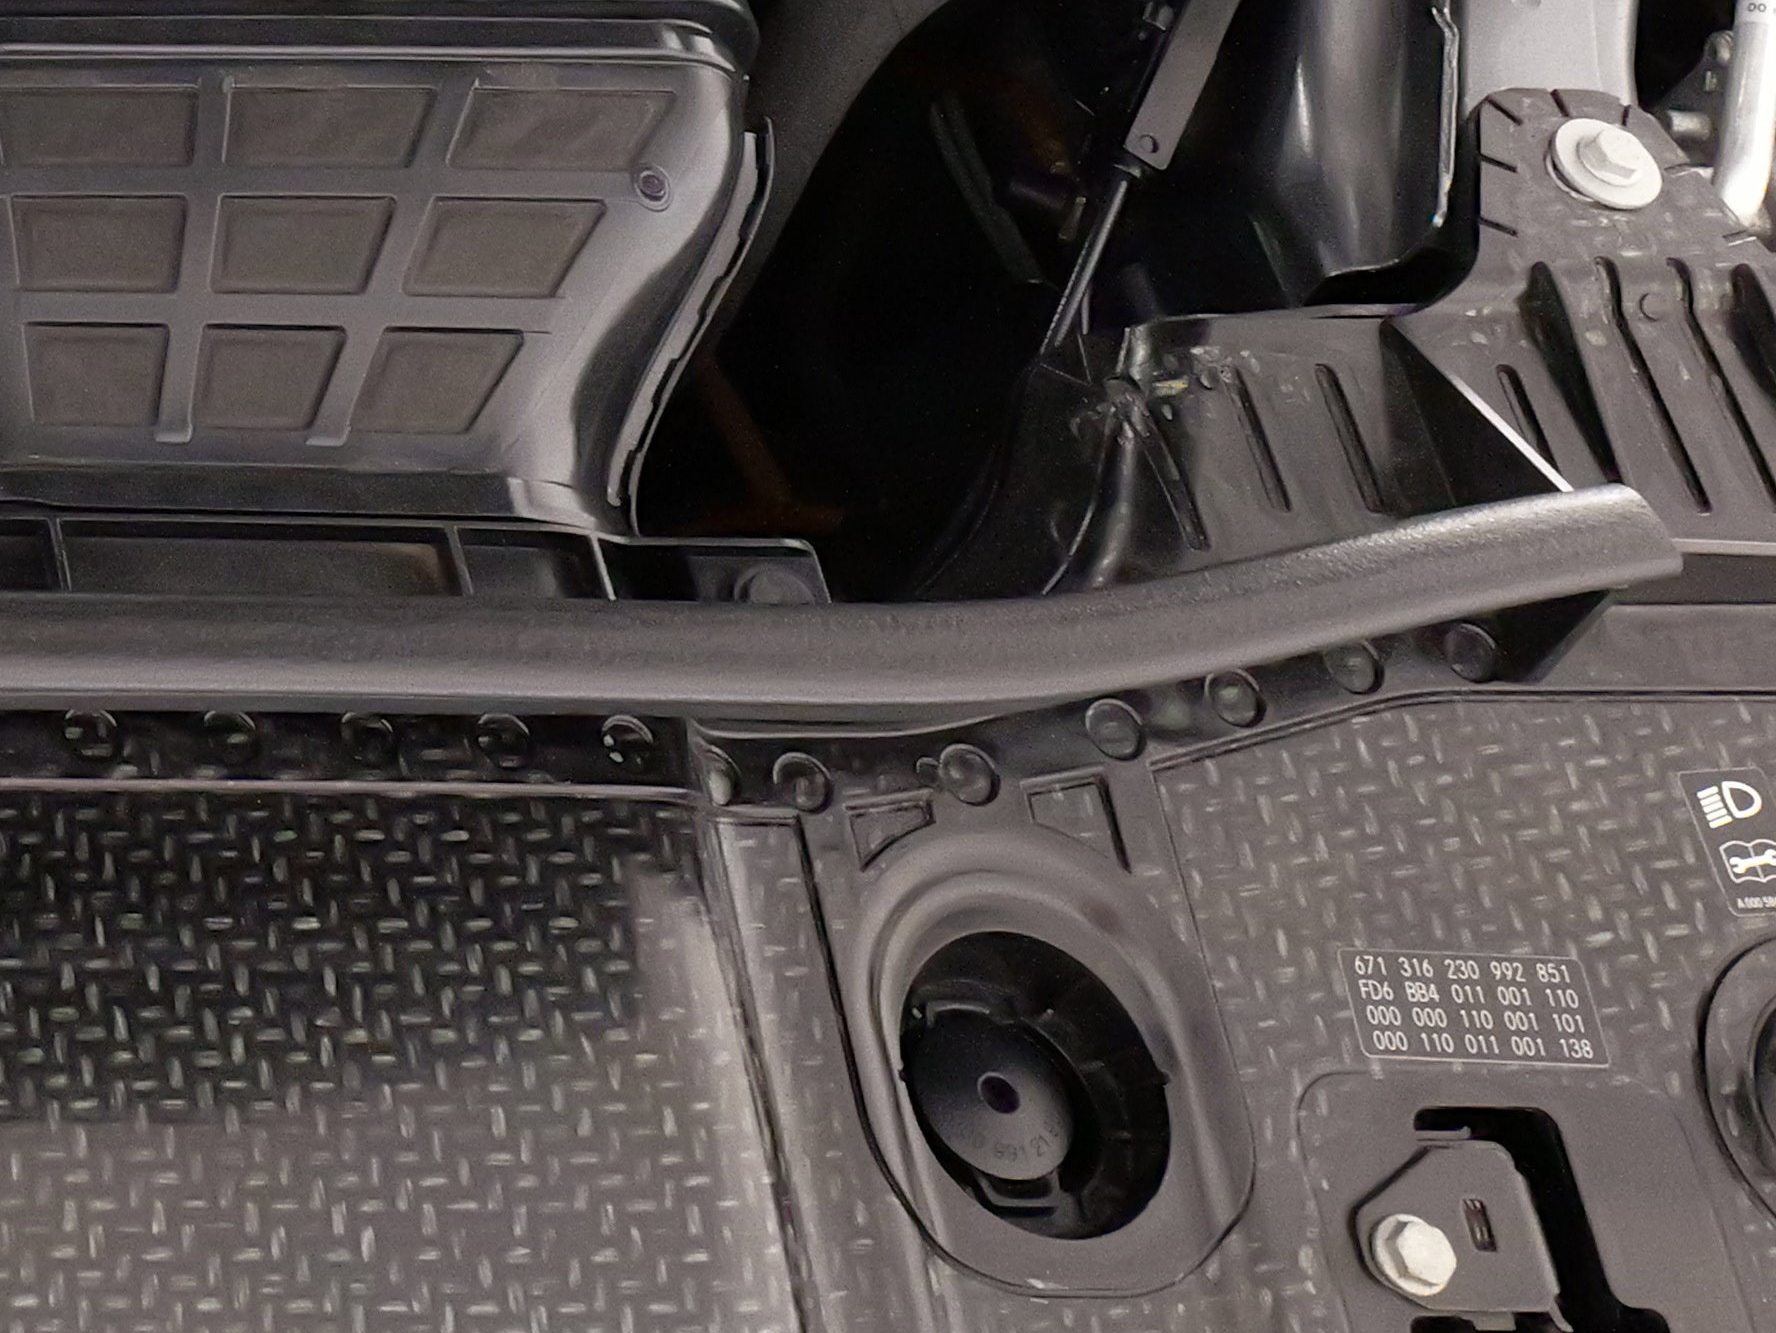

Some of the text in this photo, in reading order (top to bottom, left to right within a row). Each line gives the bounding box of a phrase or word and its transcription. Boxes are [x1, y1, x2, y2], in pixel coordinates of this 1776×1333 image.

[1354, 955, 1571, 984] 671 316 230 992 851
[1358, 979, 1580, 1009] FD6 BB4 011 001 110
[1366, 1005, 1586, 1034] 000 000 110 001 101
[1372, 1030, 1594, 1060] 000 110 011 001 138
